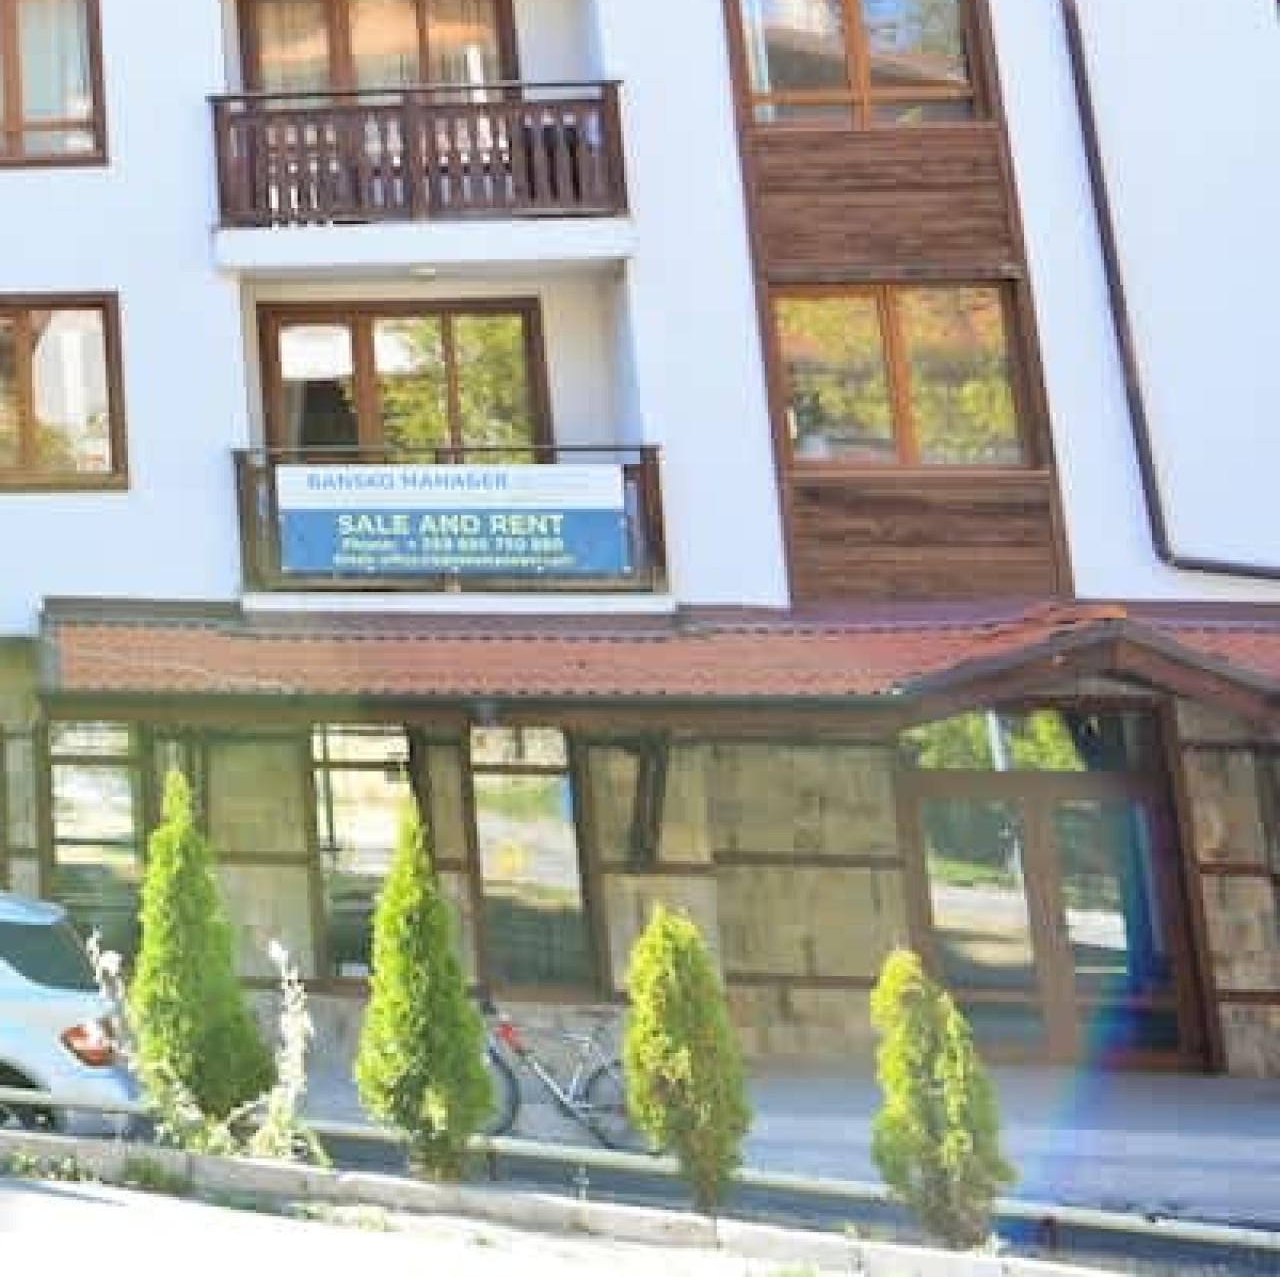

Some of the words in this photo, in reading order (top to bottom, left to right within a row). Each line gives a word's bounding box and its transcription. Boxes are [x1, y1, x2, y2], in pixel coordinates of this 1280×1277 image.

[337, 514, 410, 535] SALE
[420, 514, 481, 535] AND
[490, 514, 564, 535] RENT
